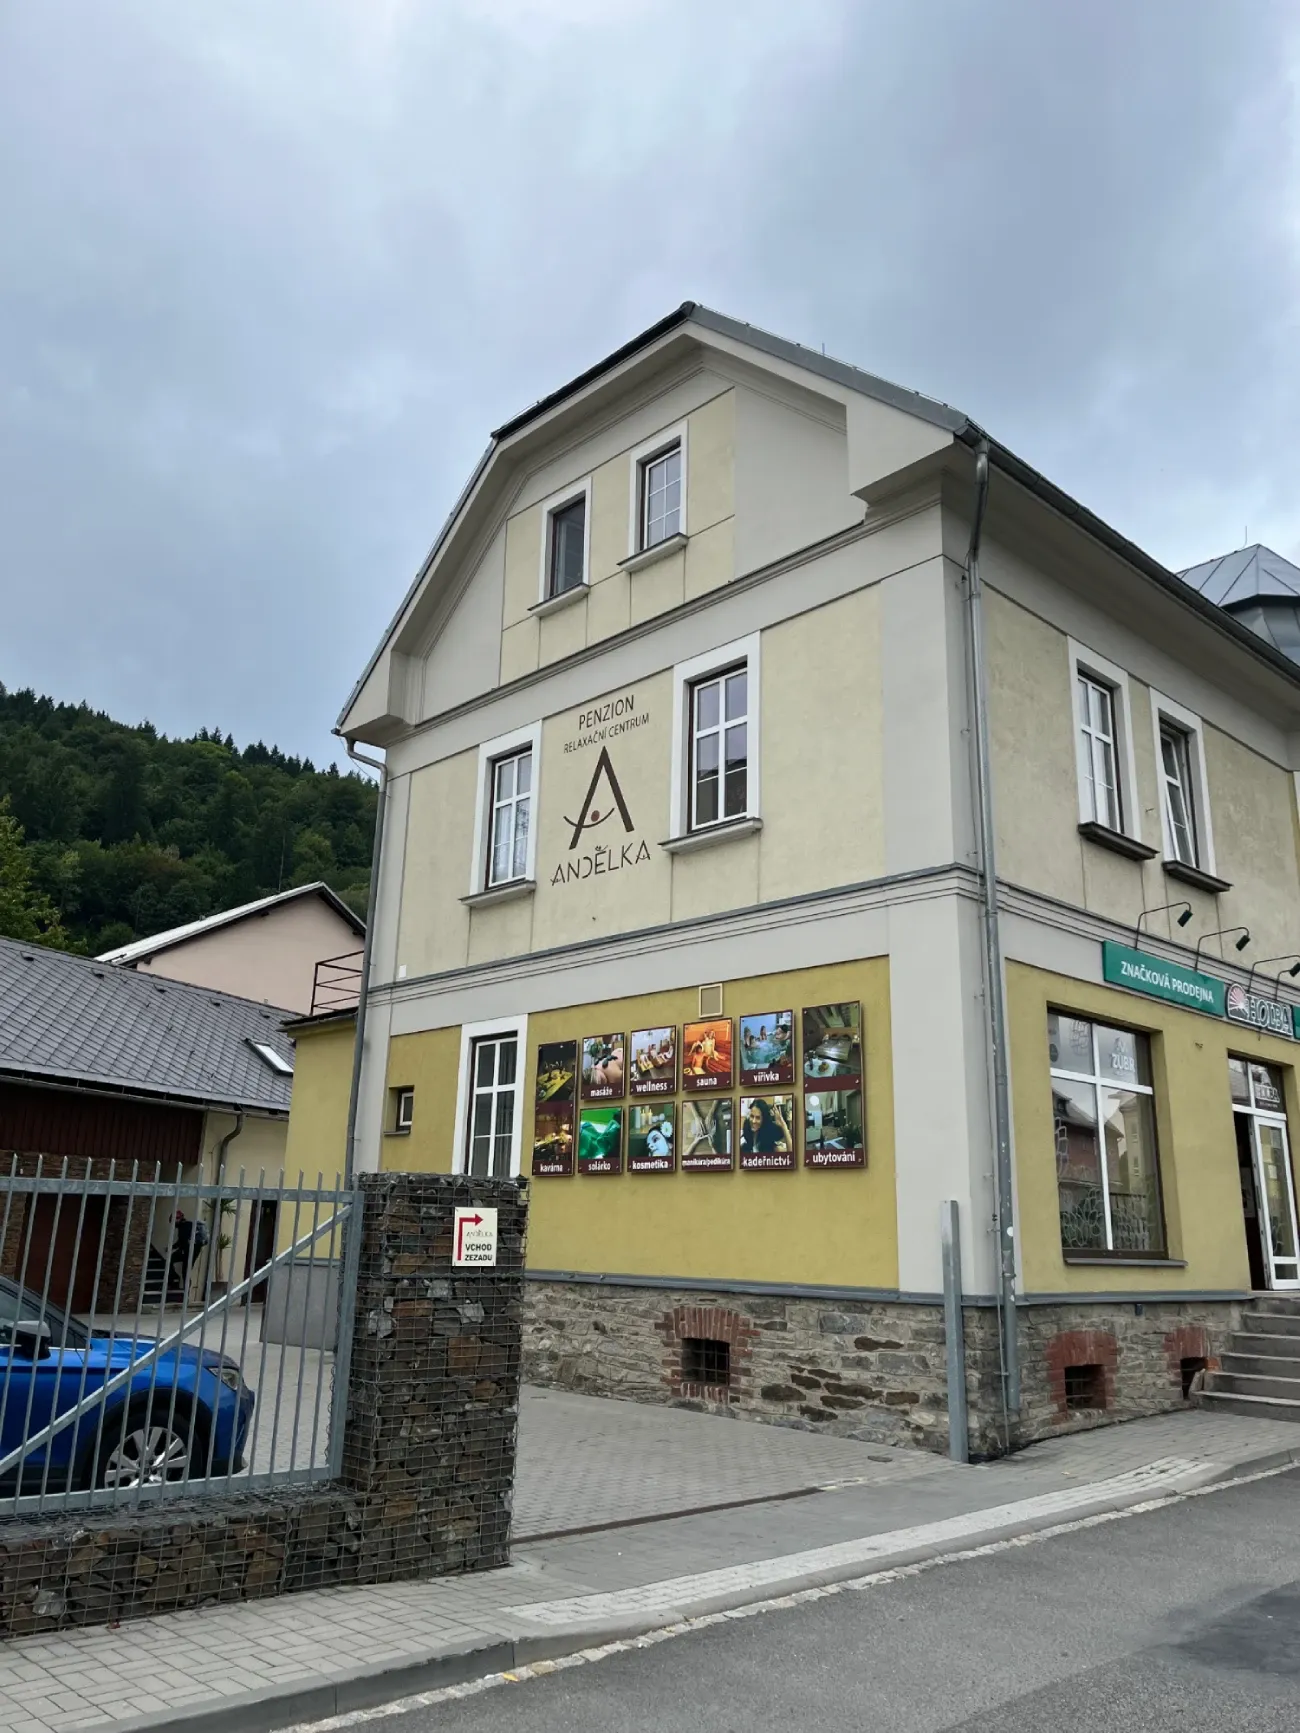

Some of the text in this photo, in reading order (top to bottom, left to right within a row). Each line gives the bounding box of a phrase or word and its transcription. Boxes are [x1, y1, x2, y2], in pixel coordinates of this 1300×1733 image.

[578, 694, 634, 730] PENZION
[563, 712, 650, 754] RELAXAČNÍ CENTRUM
[1120, 961, 1215, 1004] ZNAČKOVÁ PRODEJNA
[636, 1080, 668, 1092] wellness
[696, 1076, 718, 1087] sauna
[590, 1087, 613, 1097] masáže
[632, 1158, 669, 1170] kosmetika
[743, 1152, 790, 1167] kadeřnictví
[465, 1243, 493, 1251] VCHOD
